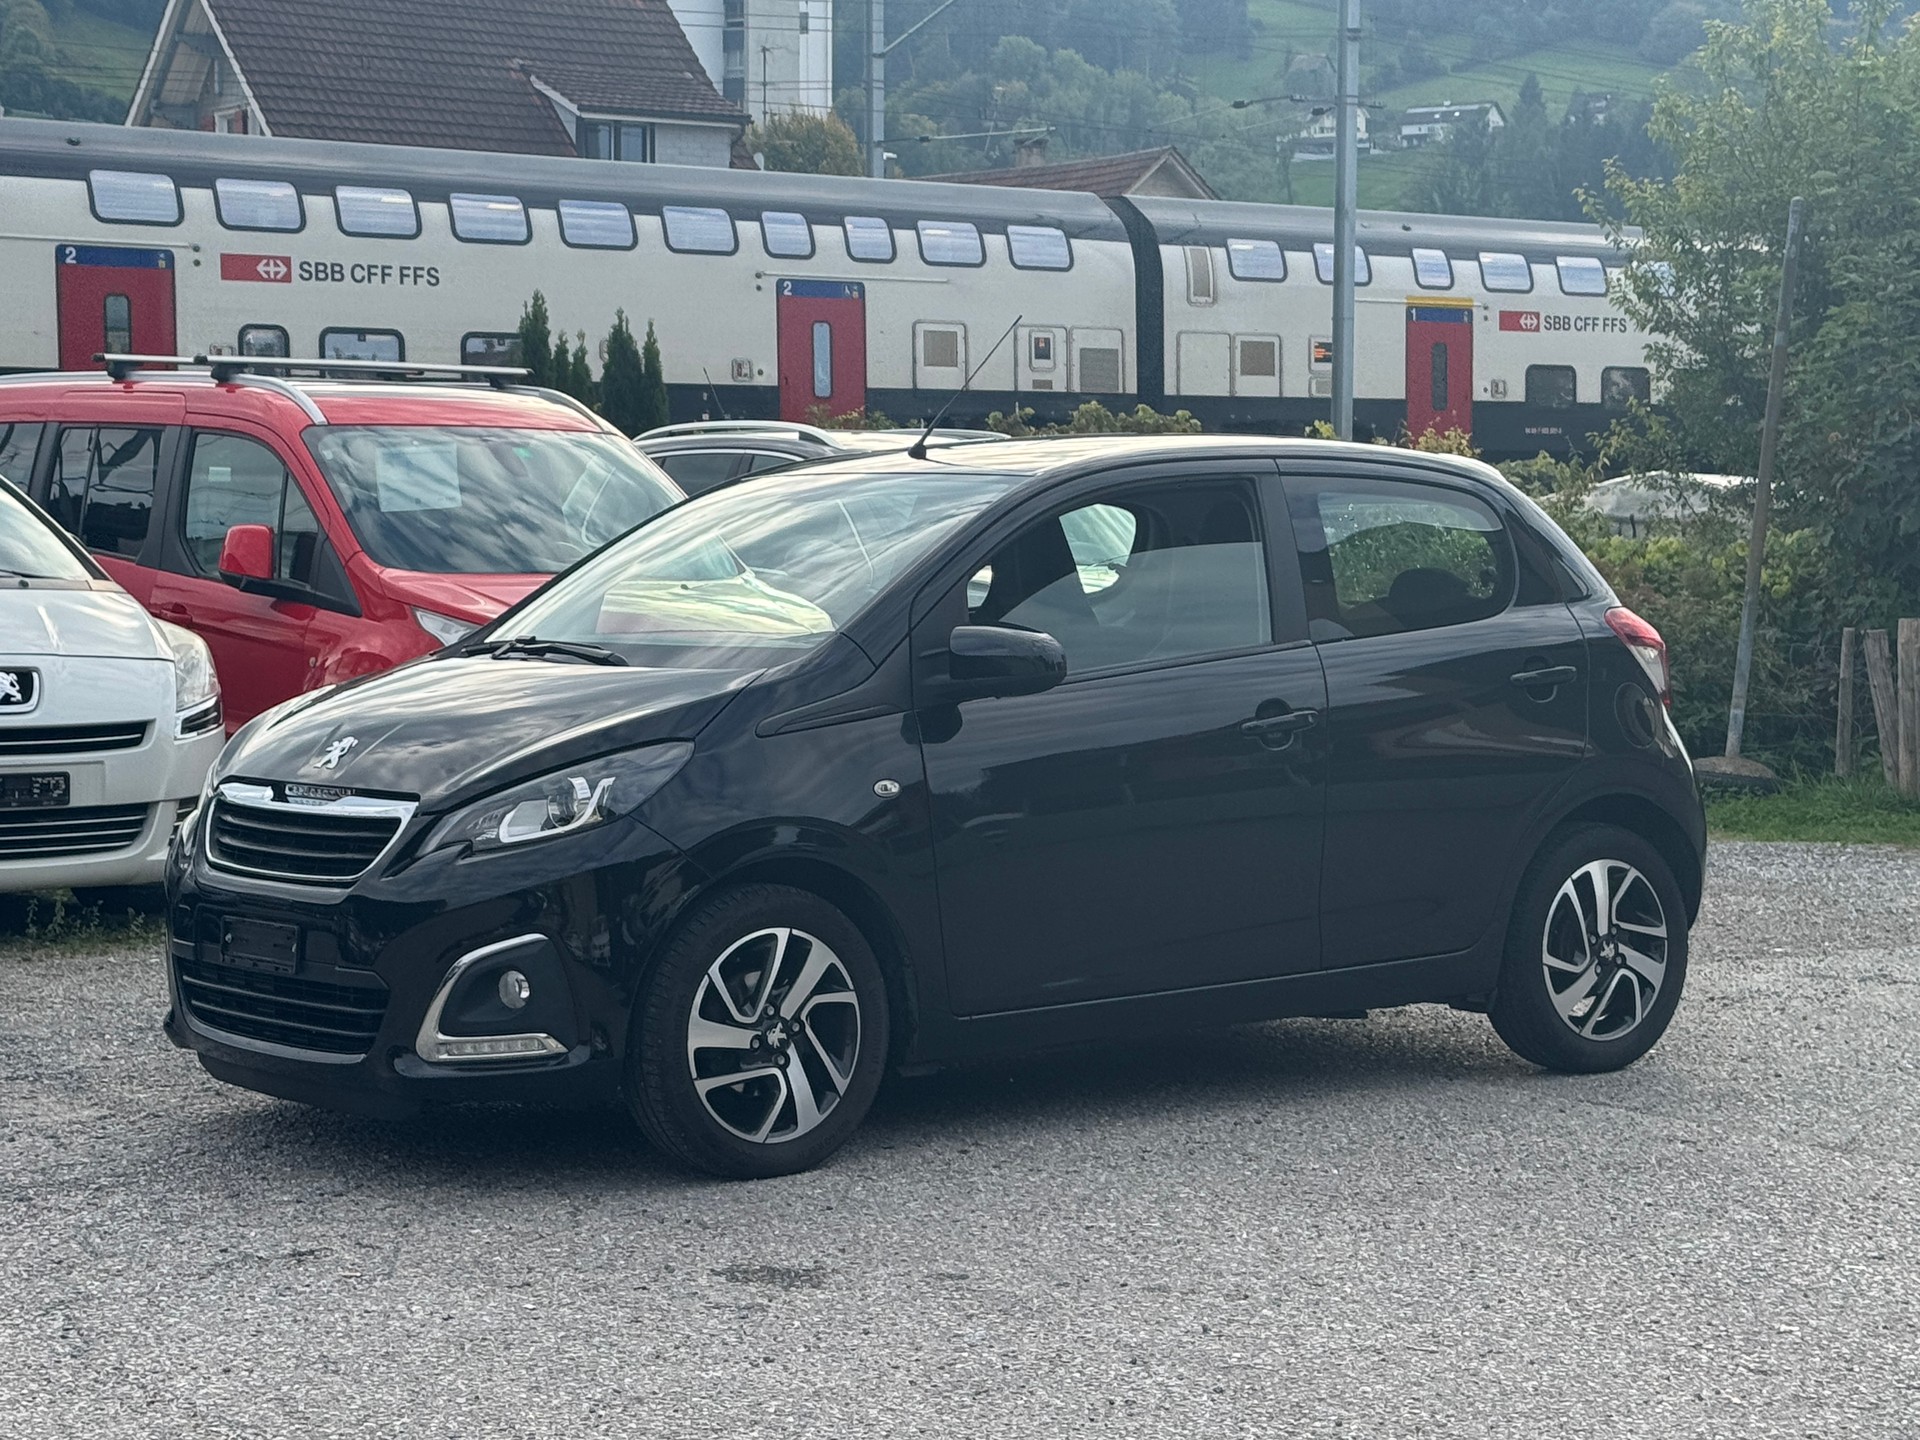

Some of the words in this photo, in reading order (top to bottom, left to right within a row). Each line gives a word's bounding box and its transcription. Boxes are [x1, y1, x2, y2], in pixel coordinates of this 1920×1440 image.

[64, 246, 77, 264] 2
[298, 260, 345, 282] SBB
[350, 263, 393, 284] CFF
[399, 265, 440, 286] FFS
[783, 280, 793, 296] 2
[1543, 314, 1571, 331] SBB
[1573, 315, 1599, 332] CFF
[1602, 317, 1627, 333] FFS
